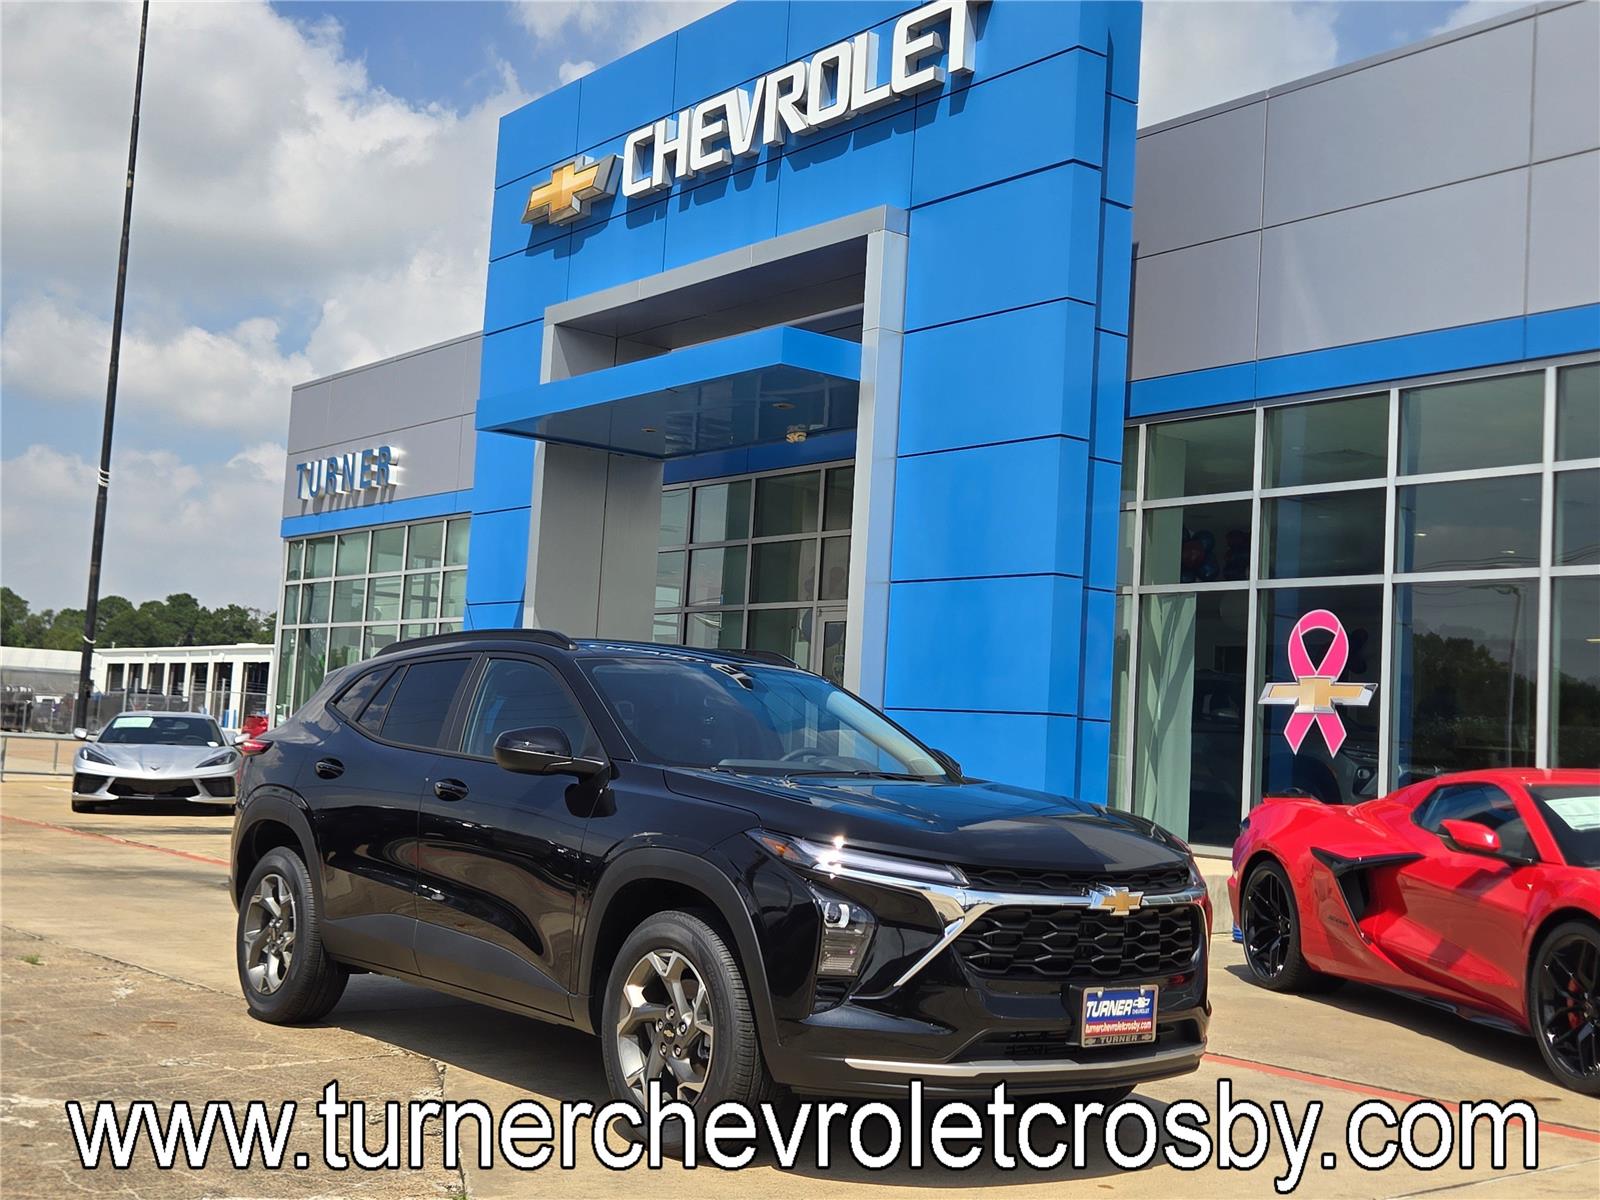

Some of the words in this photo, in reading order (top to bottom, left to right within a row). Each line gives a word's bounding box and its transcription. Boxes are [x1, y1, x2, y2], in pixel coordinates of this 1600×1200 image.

[622, 0, 986, 197] CHEVROLET
[296, 446, 398, 500] TURNER
[1086, 999, 1133, 1018] TURNER
[1101, 1034, 1138, 1044] TURNER
